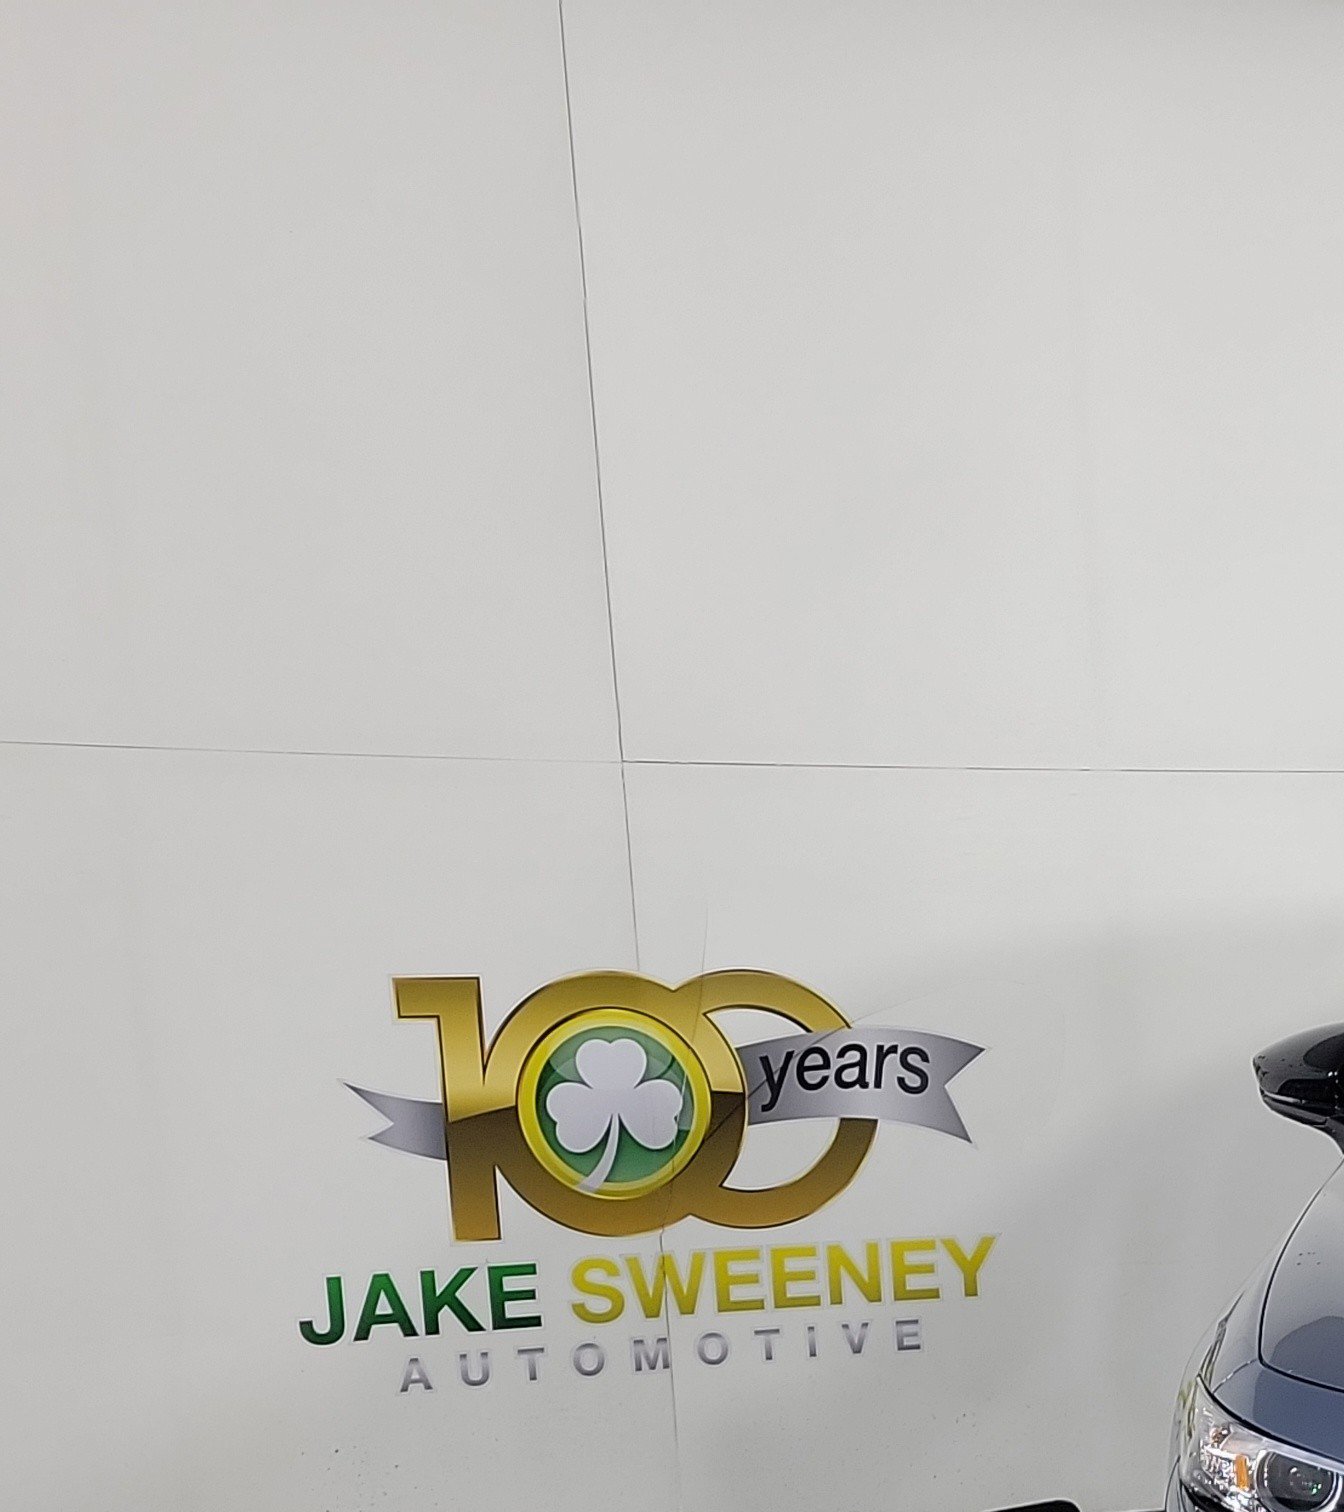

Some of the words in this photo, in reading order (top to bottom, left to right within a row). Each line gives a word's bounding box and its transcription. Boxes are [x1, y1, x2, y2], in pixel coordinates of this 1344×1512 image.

[392, 969, 878, 1243] 100
[760, 1039, 930, 1113] years
[299, 1262, 543, 1346] JAKE
[570, 1235, 997, 1324] SWEENEY
[399, 1319, 924, 1393] AUTOMOTIVE
